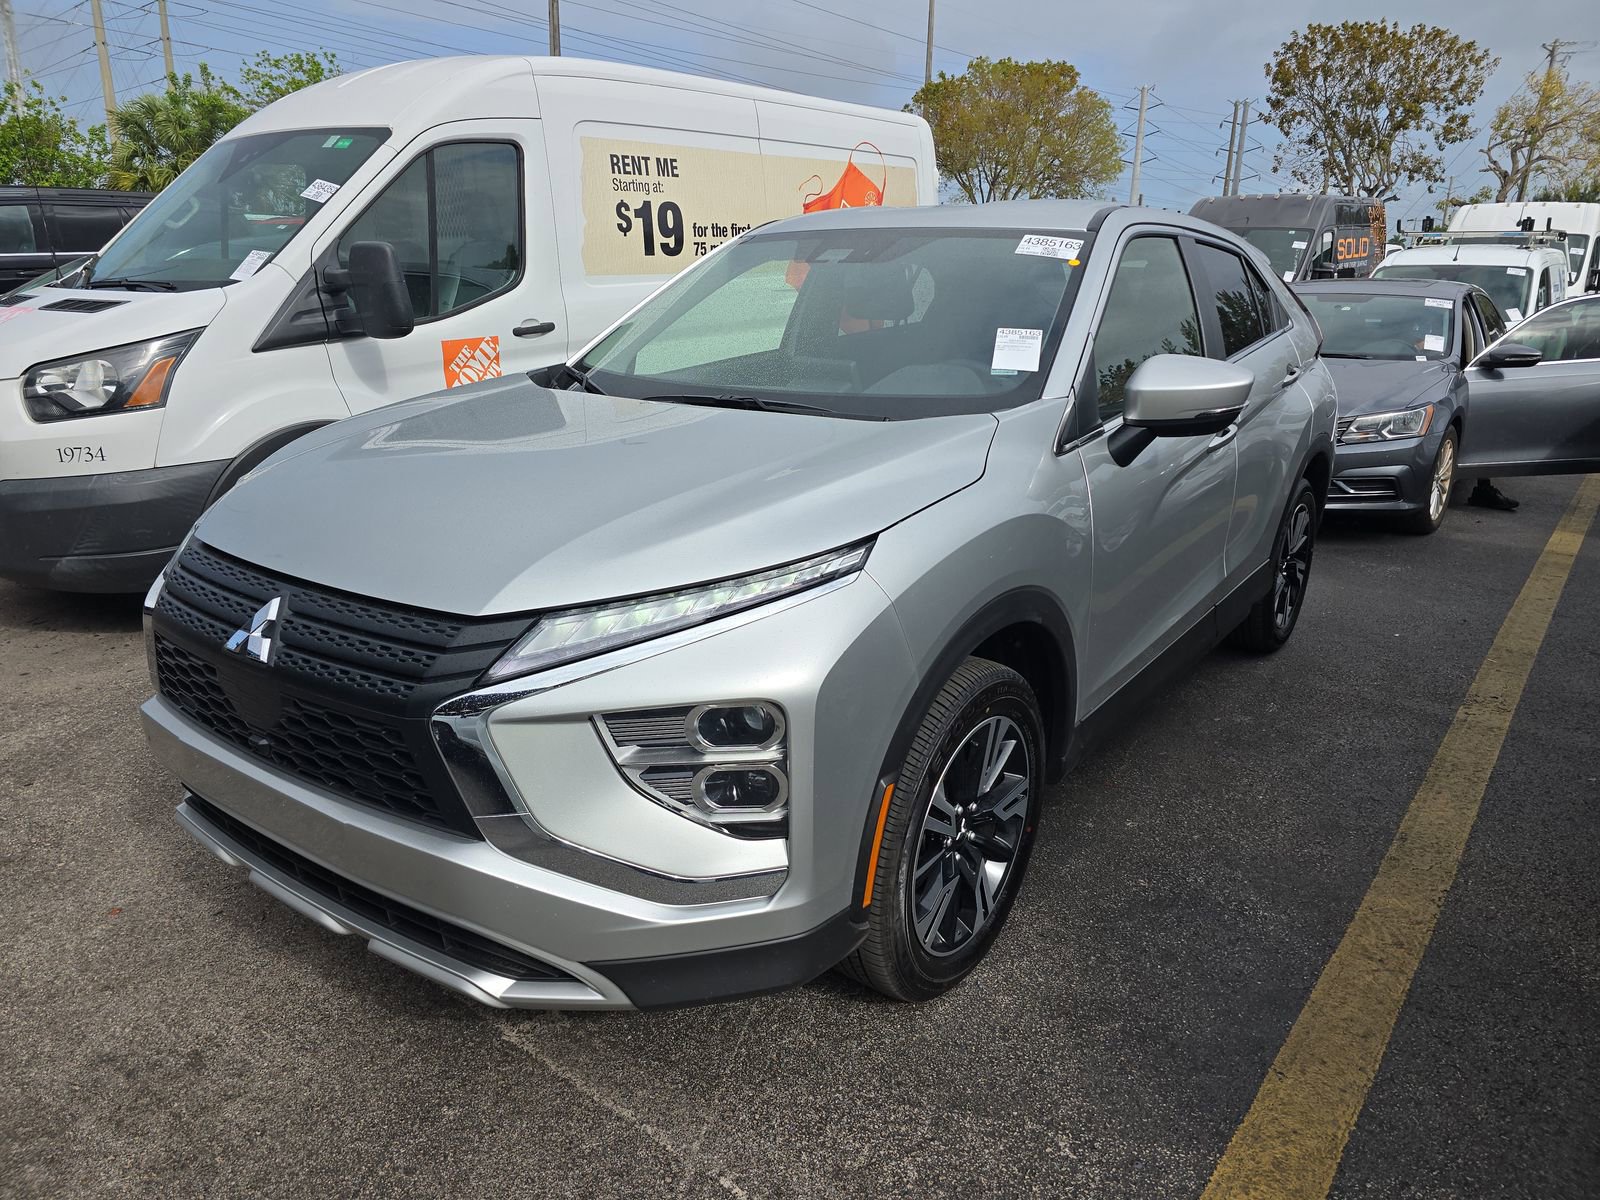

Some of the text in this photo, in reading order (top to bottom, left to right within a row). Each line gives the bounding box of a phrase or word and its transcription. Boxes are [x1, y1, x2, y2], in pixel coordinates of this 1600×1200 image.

[609, 153, 680, 178] RENT ME
[612, 178, 665, 195] Starting at:
[615, 199, 685, 257] $19
[692, 222, 708, 238] for
[711, 222, 728, 238] the
[693, 241, 707, 256] 75
[1024, 237, 1082, 250] 4385163
[1337, 237, 1369, 260] SOLID
[449, 345, 473, 373] THE
[56, 446, 107, 463] 19734
